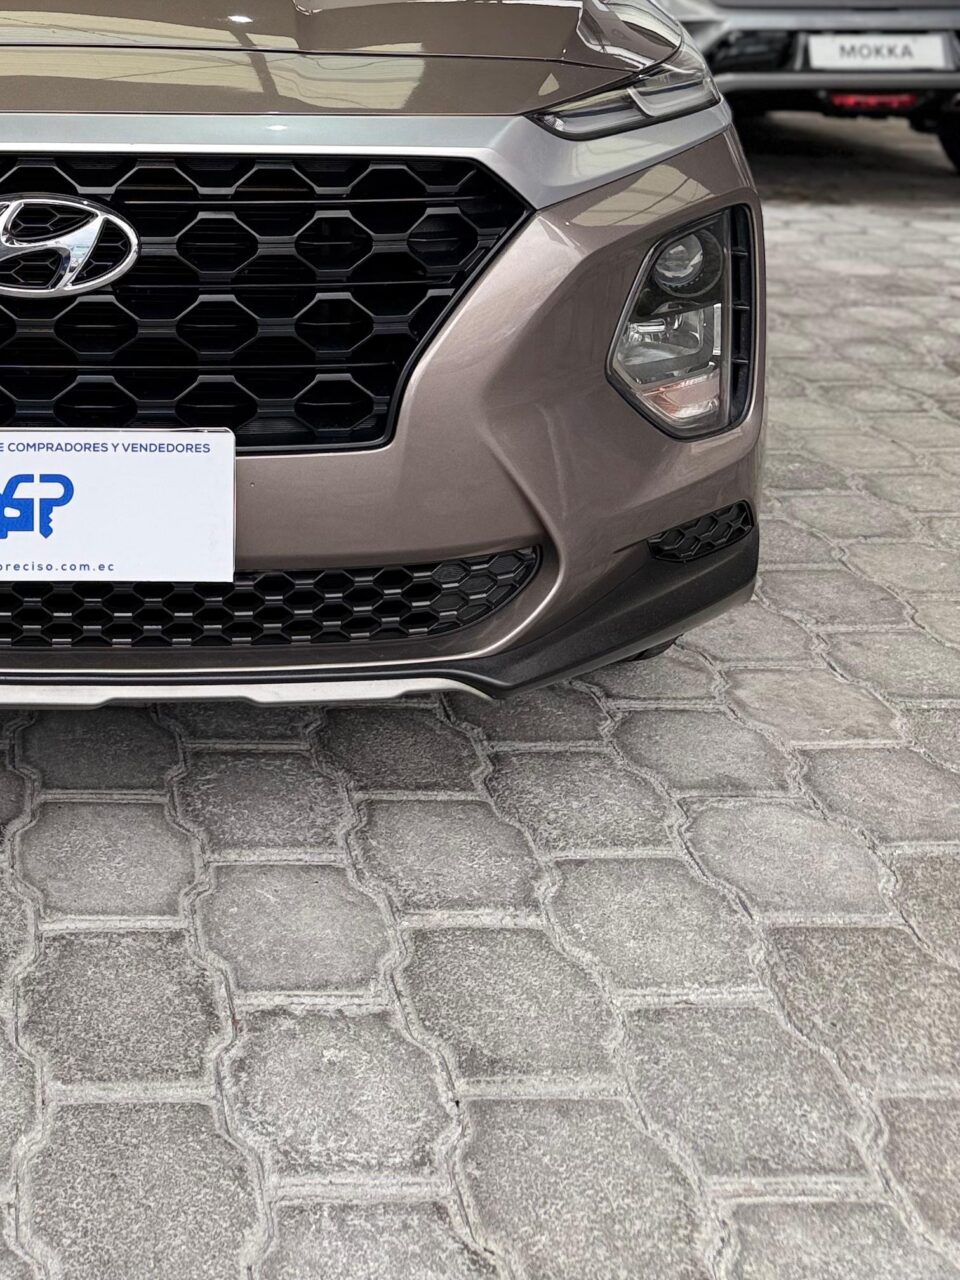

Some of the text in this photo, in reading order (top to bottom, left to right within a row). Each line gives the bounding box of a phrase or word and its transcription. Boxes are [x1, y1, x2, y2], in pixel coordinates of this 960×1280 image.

[838, 43, 915, 60] MOKKA
[7, 442, 109, 453] COMPRADORES
[111, 442, 120, 453] Y
[121, 442, 211, 454] VENDEDORES
